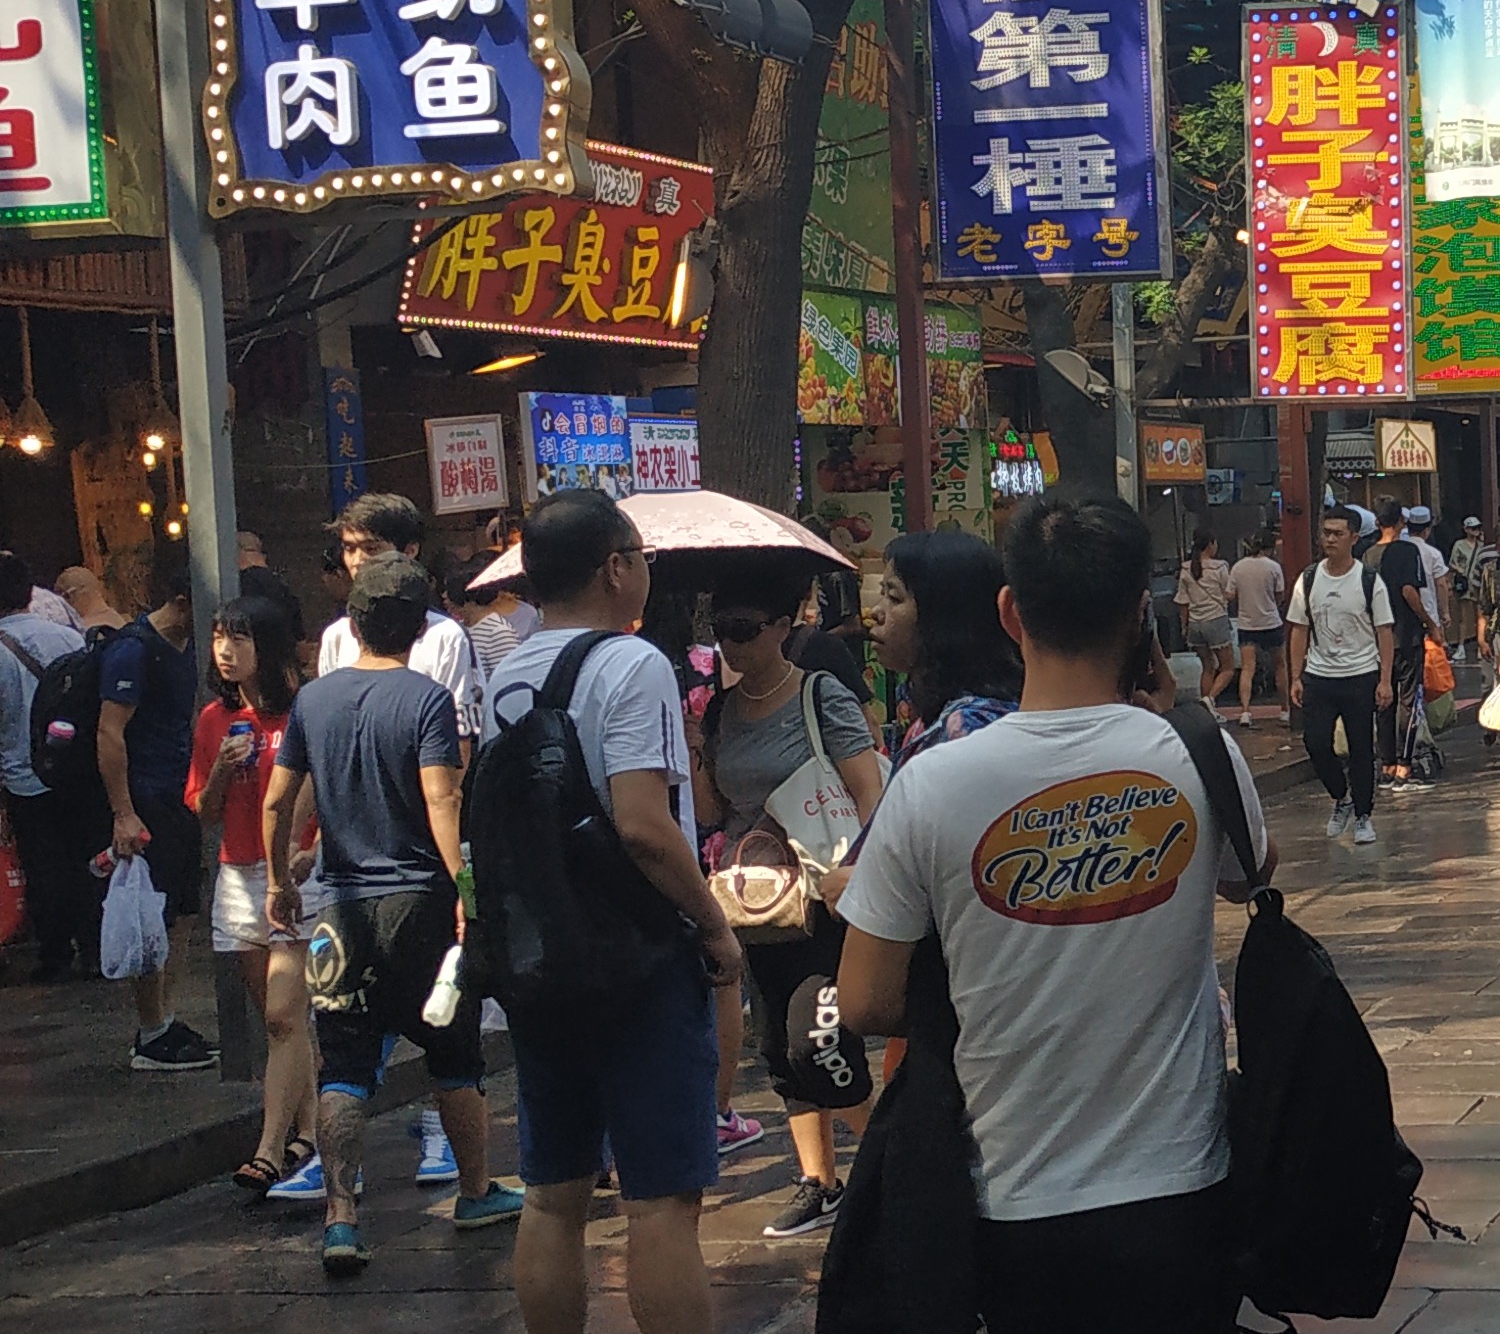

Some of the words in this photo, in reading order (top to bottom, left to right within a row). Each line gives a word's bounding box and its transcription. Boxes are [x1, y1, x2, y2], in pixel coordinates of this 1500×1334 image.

[1264, 23, 1299, 60] 清
[1350, 20, 1385, 56] 真
[655, 176, 681, 216] 真
[956, 218, 1140, 263] 老字号
[1263, 59, 1390, 386] 胖子臭豆腐
[424, 205, 704, 335] 胖子臭豆
[1010, 810, 1021, 834] I
[1022, 801, 1082, 832] Can't
[1083, 785, 1180, 819] Believe
[1046, 825, 1082, 850] It's
[1085, 815, 1133, 841] Not
[983, 820, 1188, 910] Better!
[807, 985, 855, 1089] adidas
